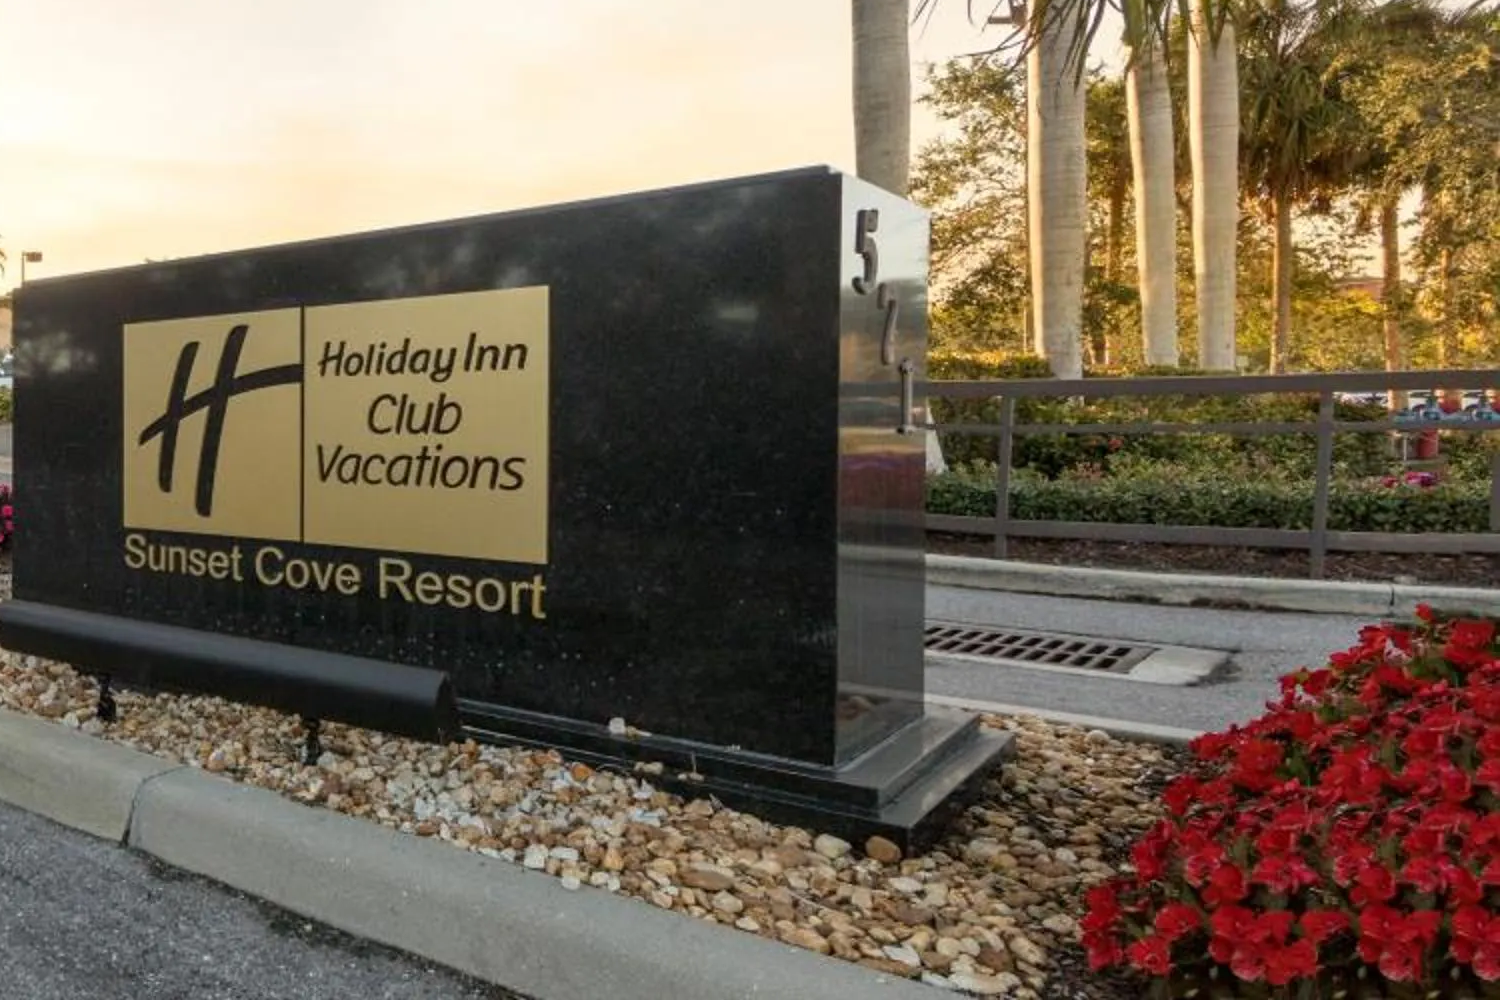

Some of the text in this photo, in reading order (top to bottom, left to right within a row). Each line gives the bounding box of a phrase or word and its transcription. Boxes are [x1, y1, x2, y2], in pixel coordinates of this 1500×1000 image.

[852, 208, 914, 434] 571
[317, 332, 528, 383] Holiday Inn
[367, 392, 463, 436] Club
[316, 443, 527, 492] Vacations
[124, 533, 547, 619] Sunset Cove Resort
